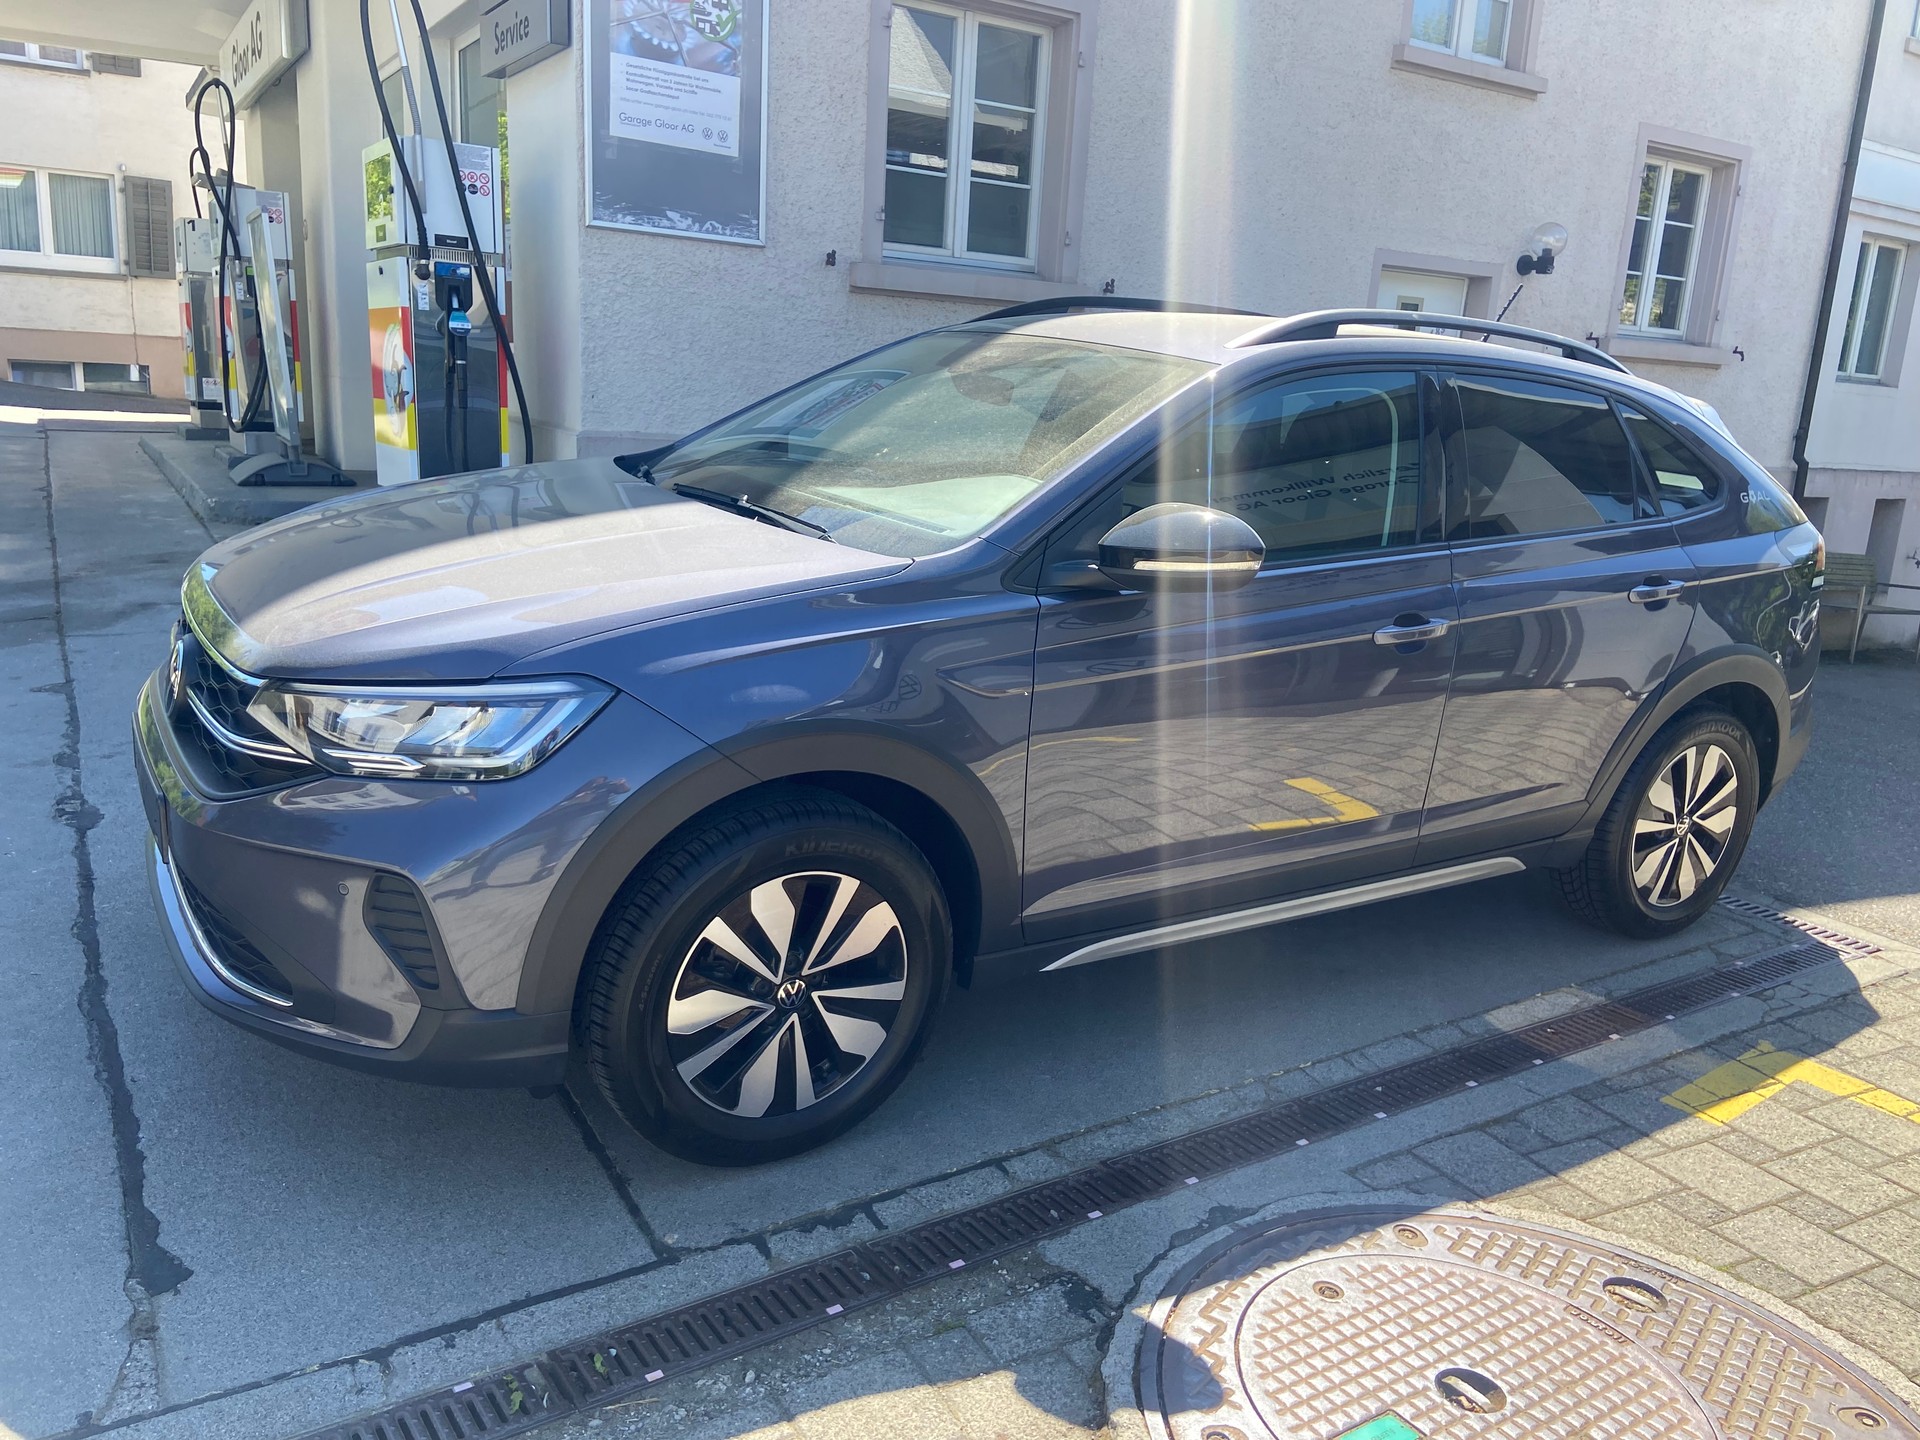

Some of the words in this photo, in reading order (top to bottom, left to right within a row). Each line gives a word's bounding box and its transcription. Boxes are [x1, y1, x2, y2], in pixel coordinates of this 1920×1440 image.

[494, 10, 529, 55] Service
[232, 39, 249, 88] Gloor
[251, 11, 262, 68] AG
[619, 112, 653, 127] Garage
[655, 118, 679, 131] Gloor
[681, 124, 695, 133] AG
[187, 219, 196, 231] 1
